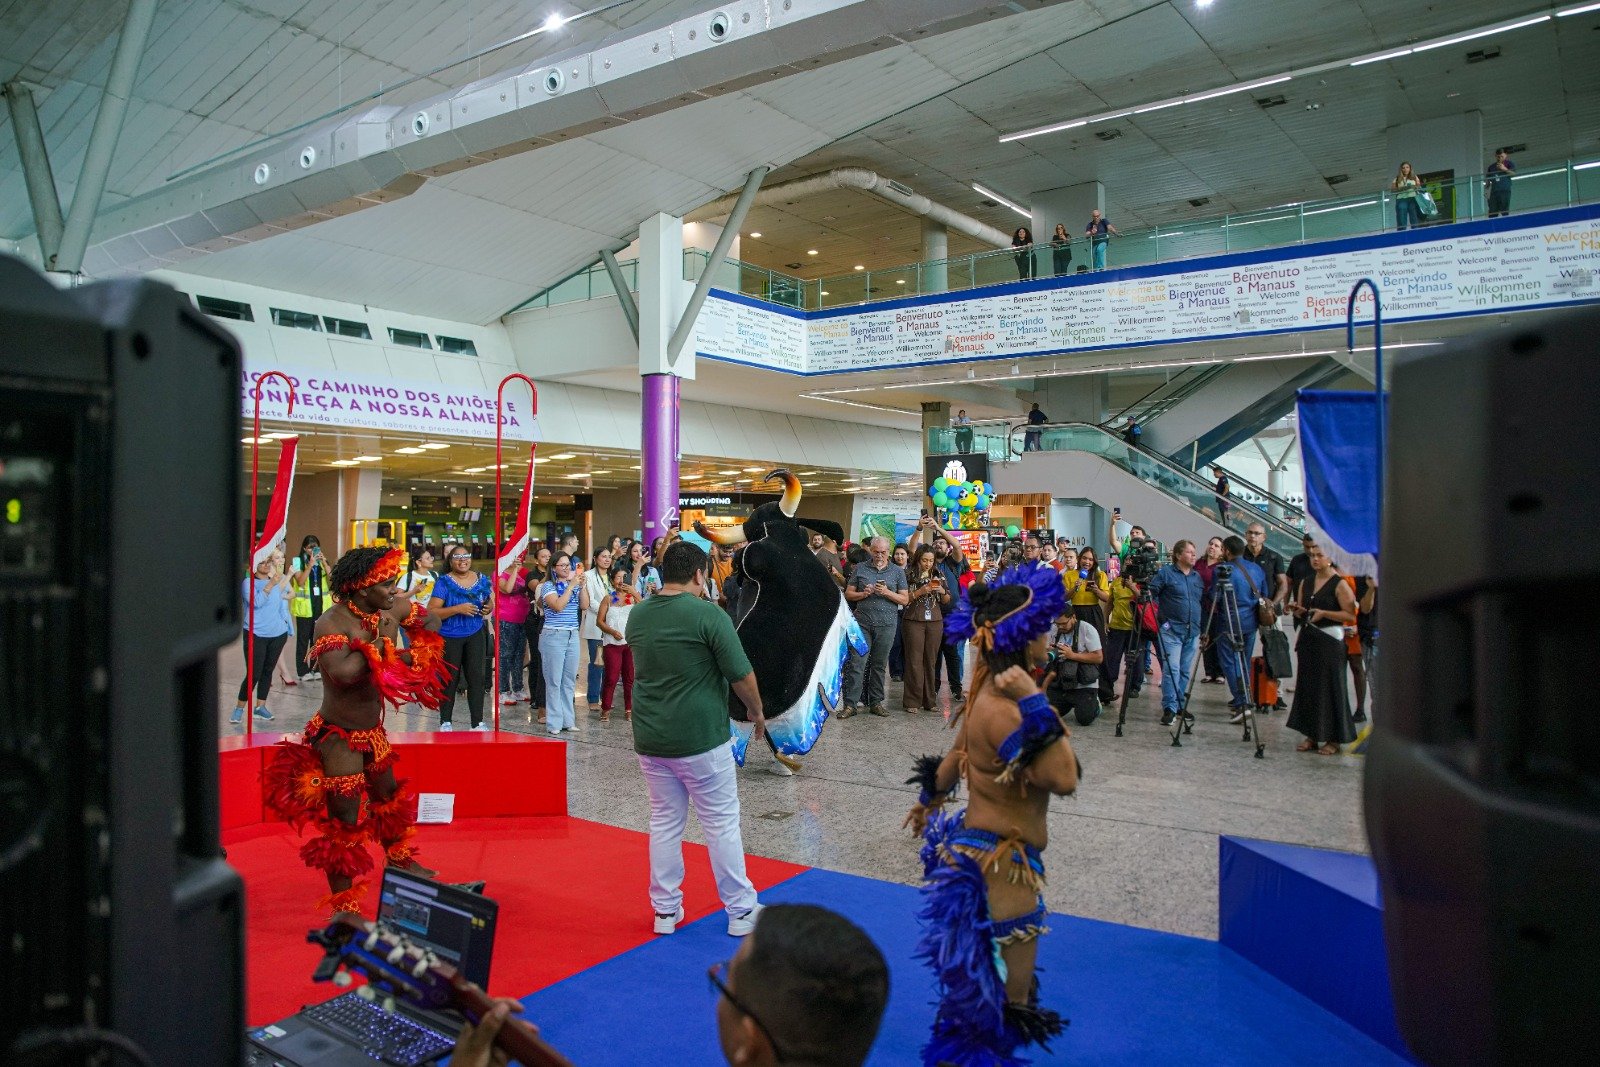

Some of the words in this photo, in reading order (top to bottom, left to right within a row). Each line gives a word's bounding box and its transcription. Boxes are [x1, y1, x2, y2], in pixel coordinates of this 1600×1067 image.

[1484, 233, 1539, 245] Willkommen
[1544, 229, 1600, 244] Welcom
[1402, 244, 1453, 256] Benvenuto
[1460, 246, 1491, 254] Benvenuto
[1504, 245, 1535, 253] Bienvenue
[1382, 259, 1415, 267] Bienvenue
[1457, 256, 1497, 265] Welcome
[1501, 256, 1540, 265] Benvenuto
[1303, 263, 1336, 271] Bem-vindo
[1378, 268, 1415, 276] Welcome
[1458, 267, 1496, 276] Bienvenido
[1233, 268, 1300, 283] Benvenuto
[1326, 269, 1374, 279] Willkommen
[1383, 271, 1447, 287] Bem-vindo
[1480, 273, 1523, 284] Bienvenue
[1107, 287, 1152, 296] Welcome
[1155, 284, 1165, 292] to
[1194, 280, 1232, 290] Benvenuto
[1237, 286, 1243, 294] a
[1248, 280, 1296, 293] Manaus
[1408, 283, 1453, 294] Manaus
[1457, 280, 1541, 296] Willkommen
[1068, 288, 1105, 297] Willkommen
[1169, 287, 1226, 300] Bienvenue
[1260, 291, 1300, 300] Welcome
[1013, 294, 1048, 304] Benvenuto
[1188, 297, 1230, 308] Manaus
[1307, 291, 1375, 307] Bienveido
[1475, 296, 1486, 306] in
[1491, 291, 1540, 304] Manaus
[1111, 305, 1145, 313] Benvenuto
[1380, 300, 1438, 311] Willkommen
[895, 310, 943, 324] Benvenuto
[1233, 308, 1287, 319] Wkommen
[1303, 311, 1309, 319] a
[1314, 307, 1360, 318] Manas
[1000, 317, 1044, 328] Bem-vindo
[1118, 316, 1166, 325] Willkommen
[1193, 315, 1231, 324] Welcome
[1260, 315, 1298, 324] Bienvenido
[808, 324, 839, 333] Welcome
[850, 325, 891, 336] Bienvenue
[898, 325, 903, 333] a
[906, 321, 940, 332] Manaus
[1016, 326, 1048, 335] Manaus
[1050, 326, 1106, 337] Willkommen
[1172, 326, 1207, 334] Bienvenido
[824, 331, 849, 339] Manaus
[863, 334, 894, 343] Manaus
[914, 330, 943, 338] Welcome
[946, 332, 995, 343] envenido
[749, 337, 769, 349] Manaus
[996, 341, 1037, 349] Willkommen
[1062, 337, 1068, 346] in
[1073, 335, 1105, 345] Manaus
[735, 348, 762, 358] Willkommen
[895, 344, 933, 352] Willkommen
[952, 343, 985, 353] Manaus
[771, 348, 803, 360] Willkommen
[784, 359, 803, 370] Manaus
[308, 379, 399, 399] CAMINHO
[405, 390, 440, 403] DOS
[446, 395, 500, 410] AVIÕES
[507, 402, 516, 412] E
[350, 399, 362, 411] A
[367, 400, 433, 419] NOSSA
[439, 408, 520, 427] ALAMEDA
[308, 413, 330, 422] vida
[382, 421, 418, 430] sabores
[428, 426, 469, 435] presentes
[471, 428, 482, 436] da
[484, 429, 525, 439] Amzônia.
